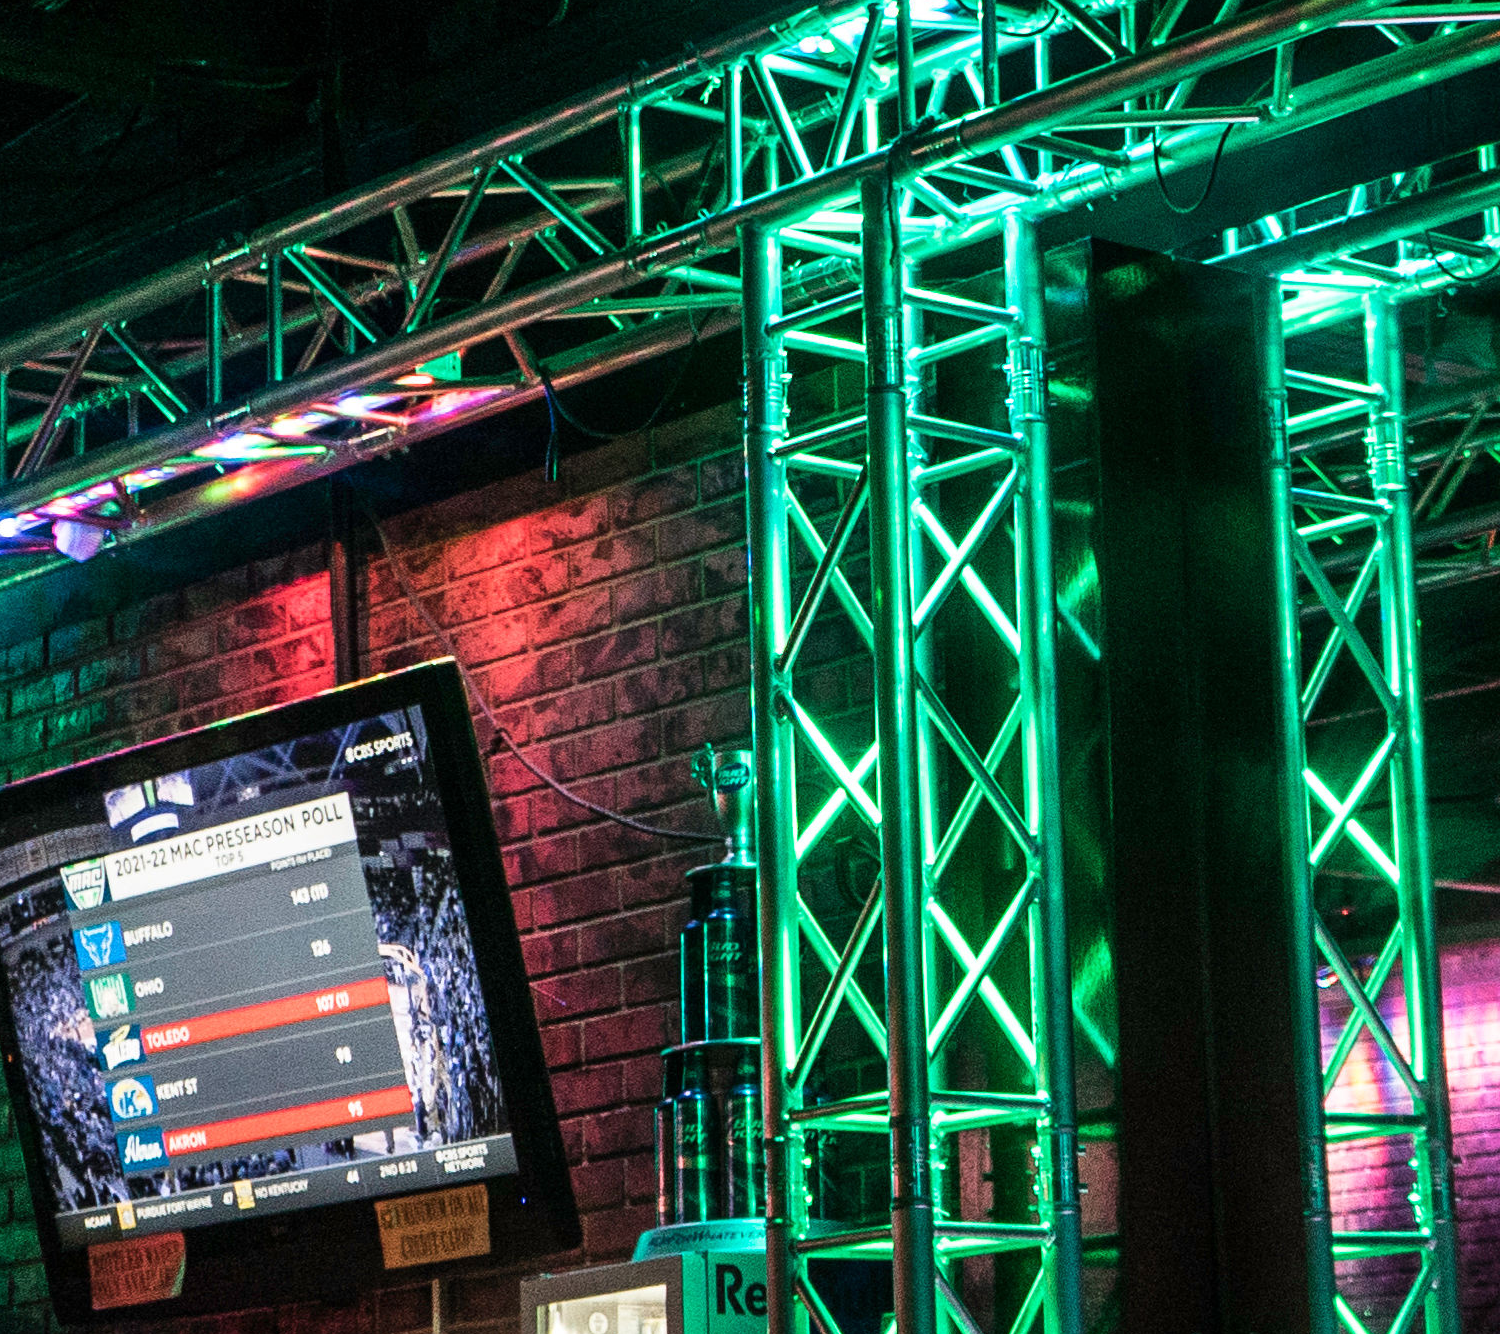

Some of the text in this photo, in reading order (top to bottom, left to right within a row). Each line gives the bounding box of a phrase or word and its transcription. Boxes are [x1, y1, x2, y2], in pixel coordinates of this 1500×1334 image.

[375, 732, 413, 755] SPORTS
[115, 803, 343, 877] 2021-22 MAC PRESEASON POLL
[215, 854, 234, 868] TOP
[124, 921, 173, 948] BUFFALO
[135, 978, 164, 998] OHIO
[146, 1027, 190, 1049] TOLEDO
[156, 1077, 198, 1101] KENT ST
[169, 1130, 207, 1153] AKRON
